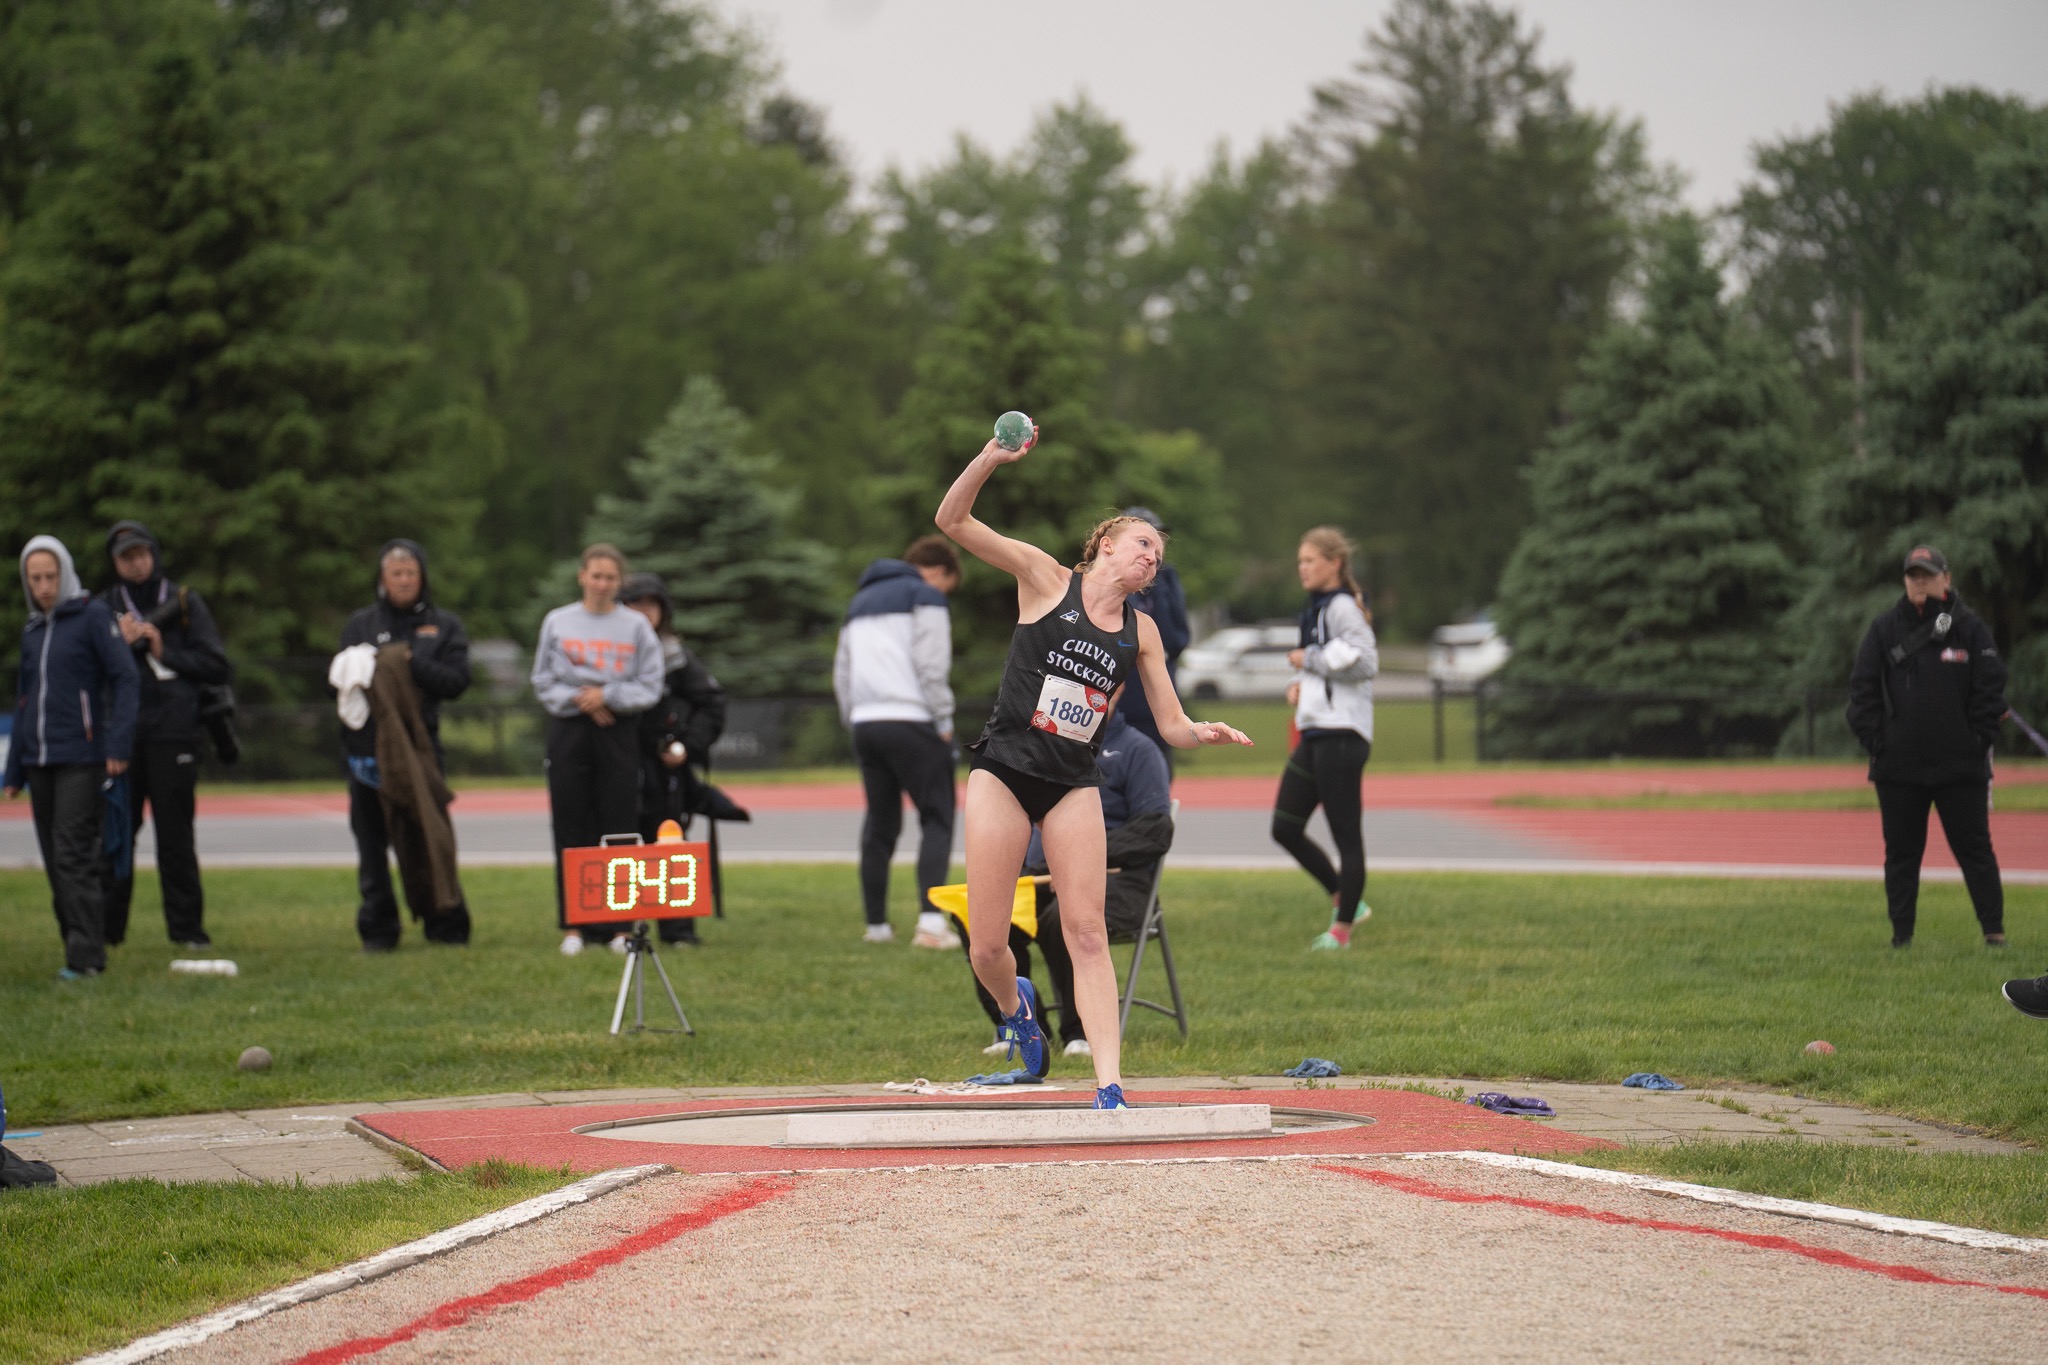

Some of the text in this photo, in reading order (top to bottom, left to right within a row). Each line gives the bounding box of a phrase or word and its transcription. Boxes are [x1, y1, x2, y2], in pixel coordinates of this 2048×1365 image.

[1046, 650, 1116, 693] STOCKTON
[1062, 639, 1117, 676] CULVER
[1050, 697, 1094, 727] 1880
[606, 853, 697, 910] 043
